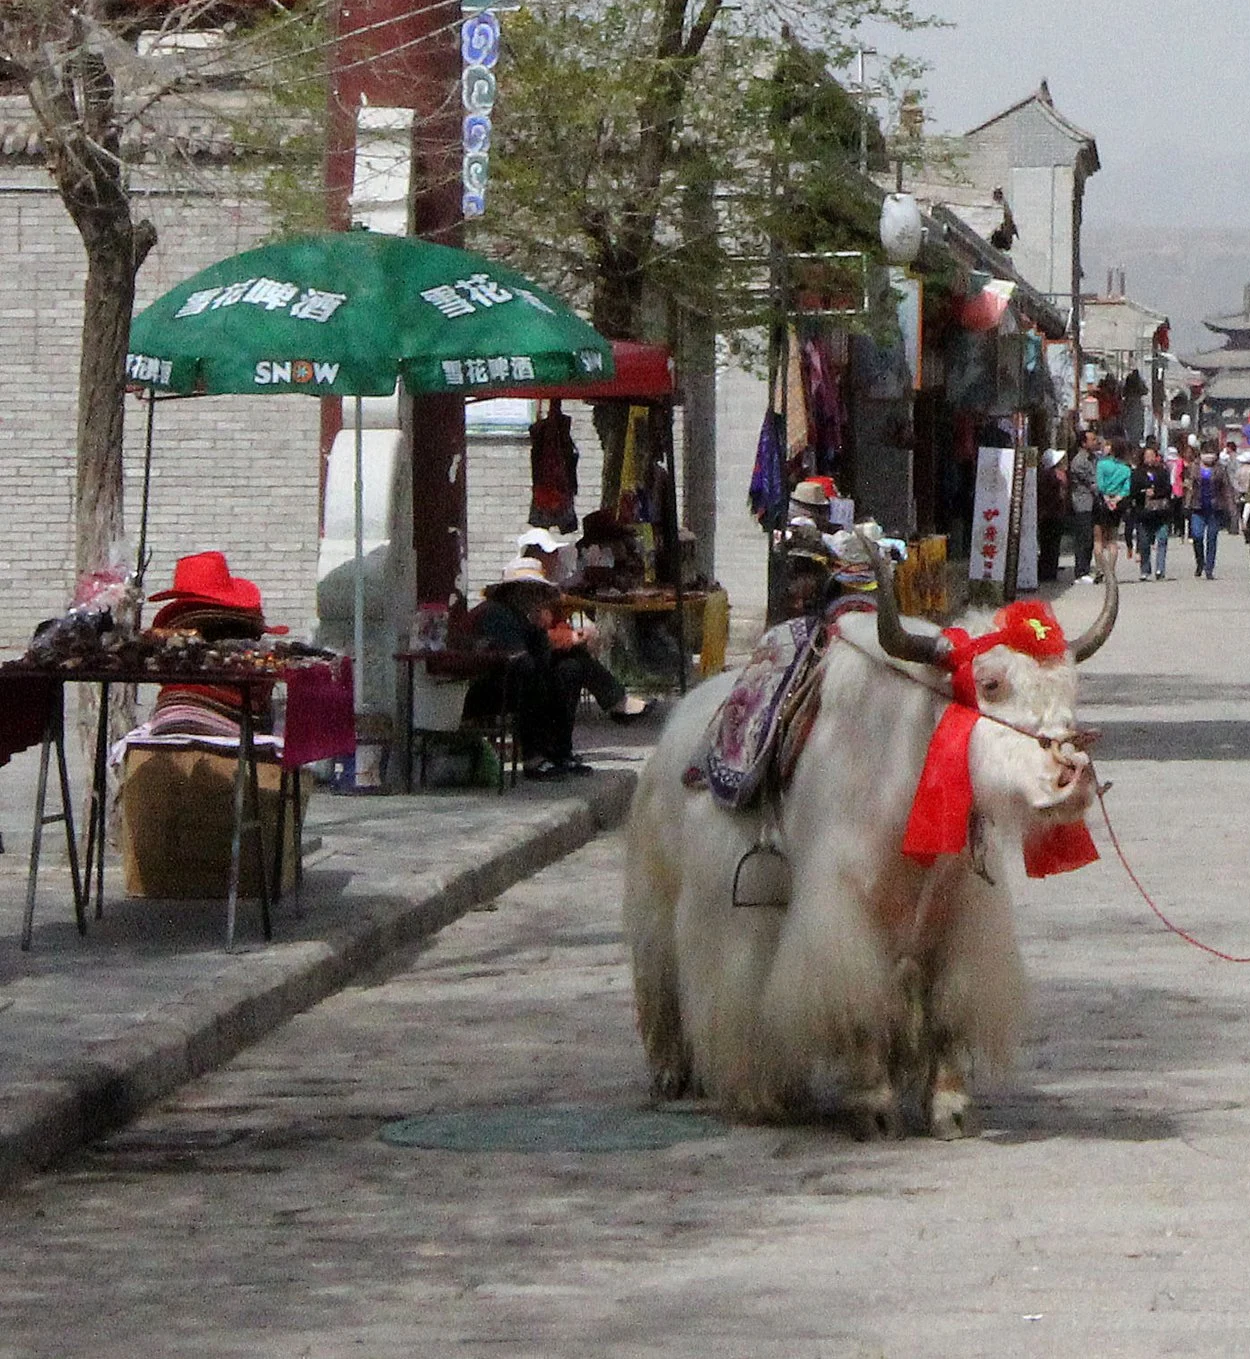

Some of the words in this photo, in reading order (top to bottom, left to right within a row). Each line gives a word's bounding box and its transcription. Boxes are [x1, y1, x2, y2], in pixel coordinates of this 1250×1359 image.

[174, 276, 347, 323] 雪花啤酒
[420, 273, 557, 319] 雪花
[254, 360, 341, 385] SNOW
[441, 356, 536, 385] 雪花啤酒
